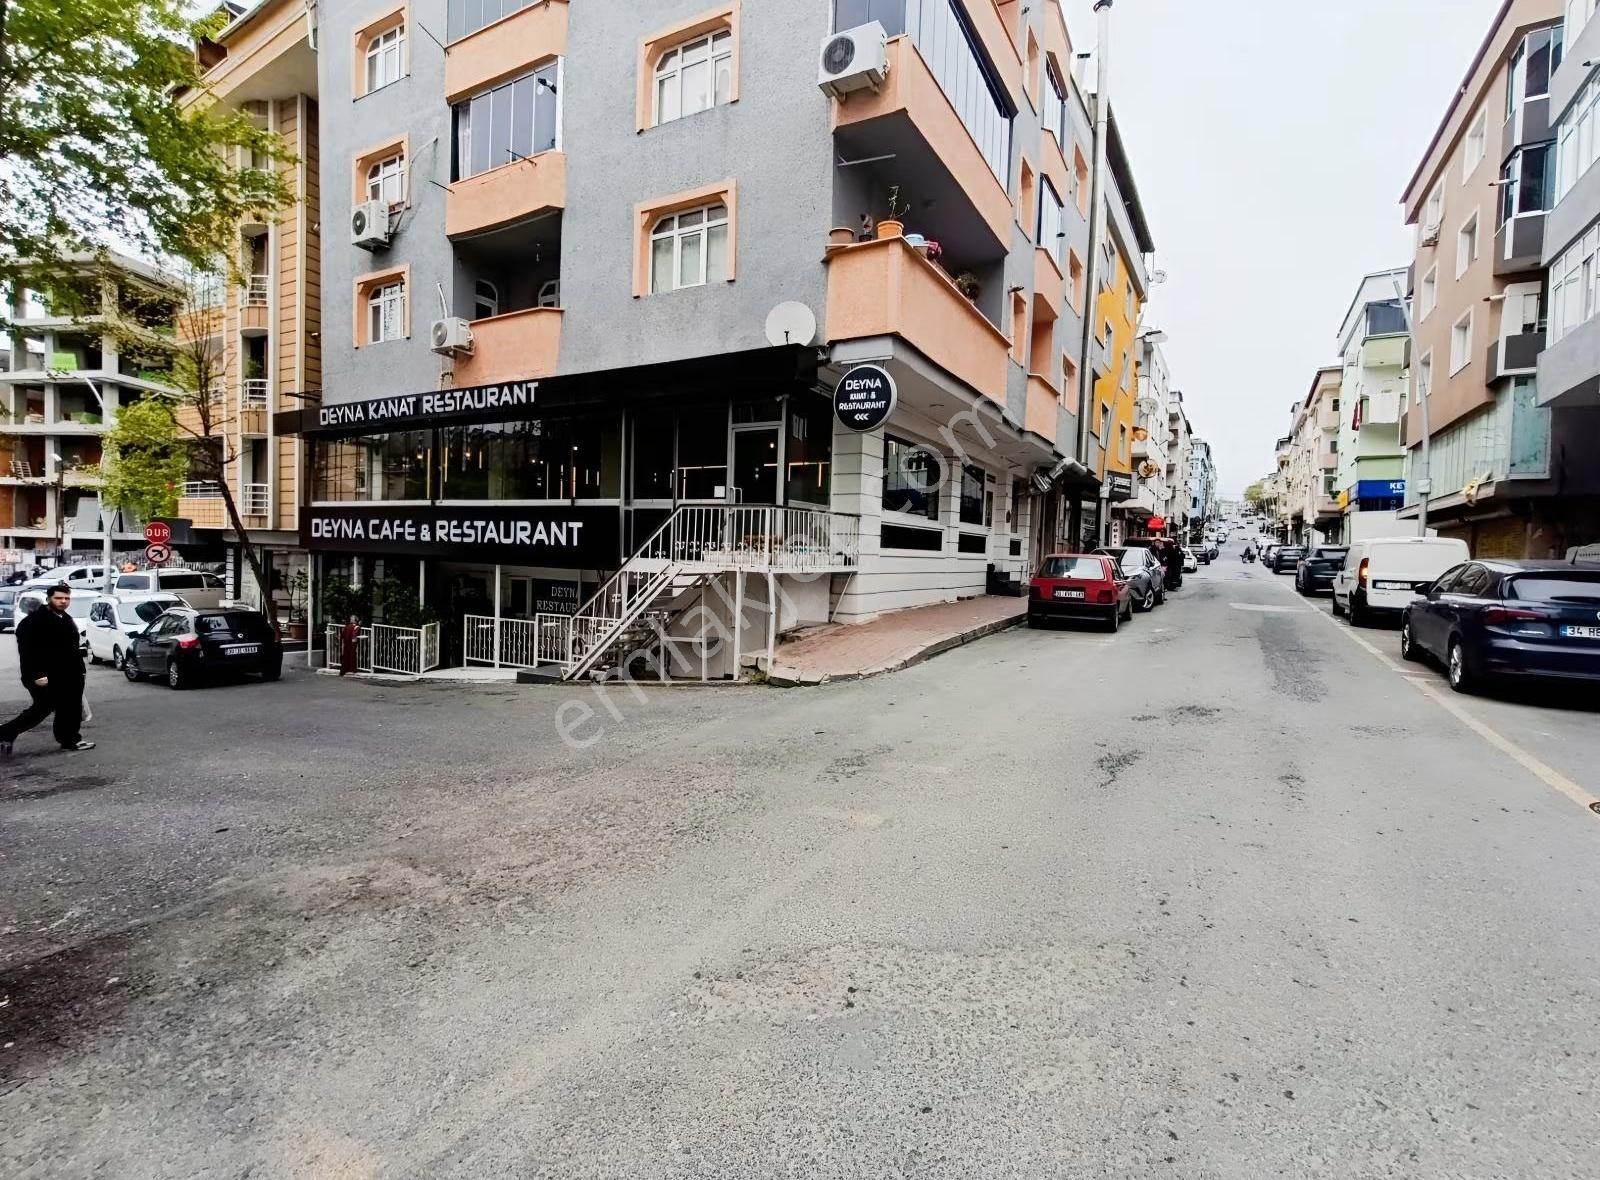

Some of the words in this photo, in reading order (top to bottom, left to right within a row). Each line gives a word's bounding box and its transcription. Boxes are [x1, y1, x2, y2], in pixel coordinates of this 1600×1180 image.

[845, 378, 882, 391] DEYNA
[319, 404, 365, 426] DEYNA
[368, 396, 417, 420] KANAT
[422, 381, 539, 414] RESTAURANT
[838, 400, 887, 411] RESTAURANT
[146, 528, 169, 537] DUR
[311, 518, 365, 538] DEYNA
[368, 519, 416, 541] CAFE
[420, 523, 431, 541] &
[435, 520, 584, 546] RESTAURANT
[536, 600, 590, 614] RESTAUR
[1568, 626, 1583, 636] 34
